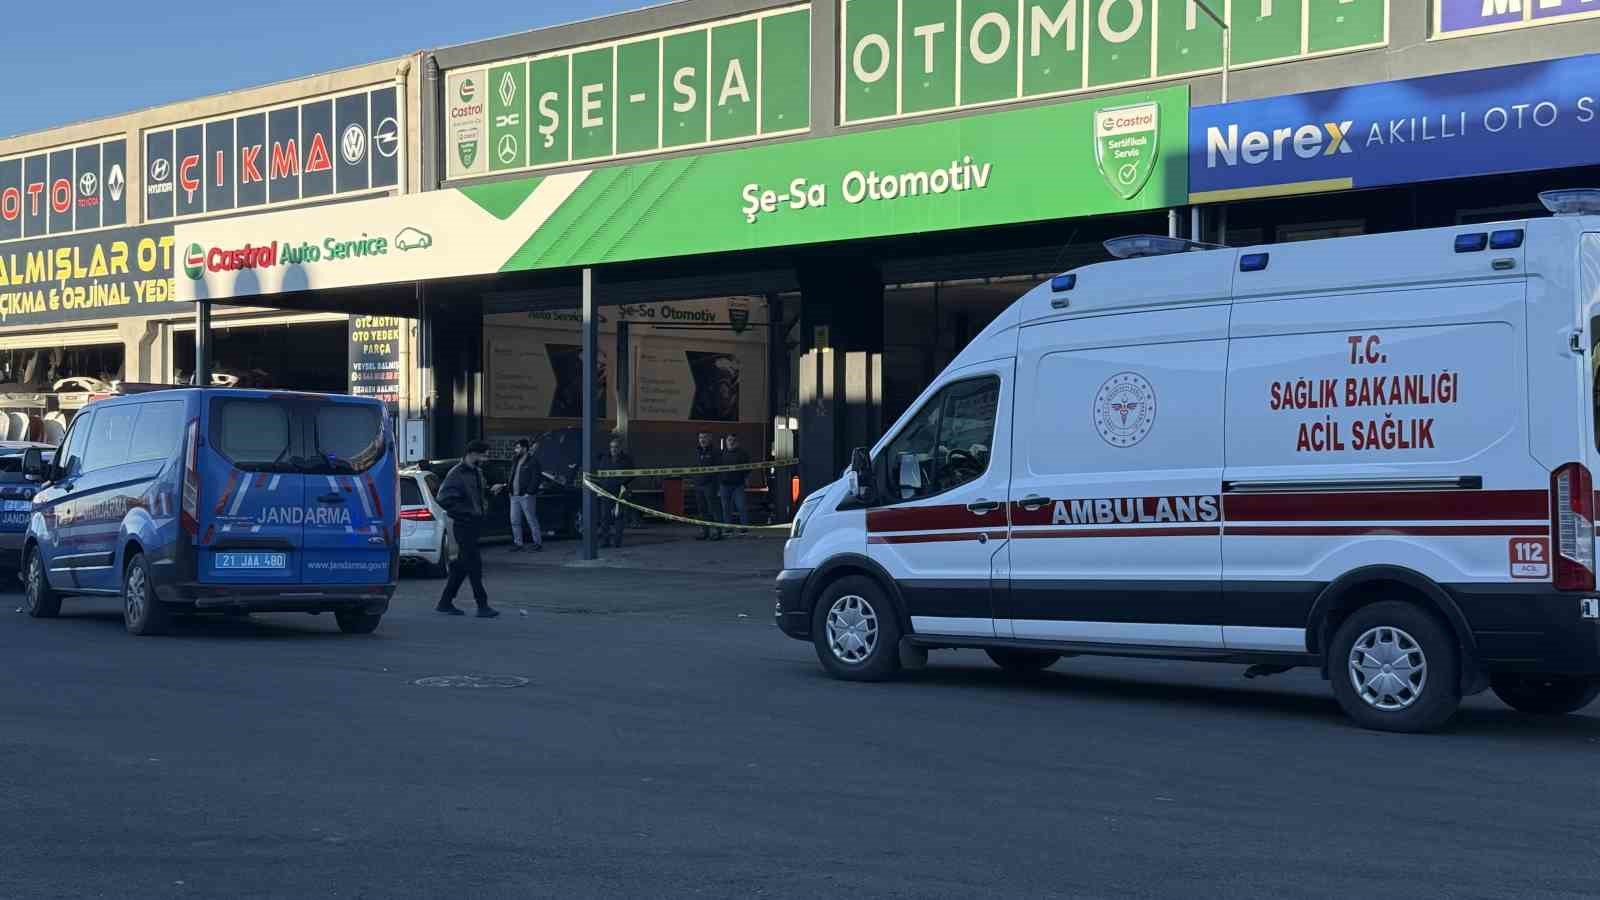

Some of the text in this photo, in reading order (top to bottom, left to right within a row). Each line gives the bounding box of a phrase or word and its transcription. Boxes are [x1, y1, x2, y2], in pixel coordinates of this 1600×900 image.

[853, 0, 1351, 83] OTOMO
[451, 104, 483, 118] Castrol
[538, 58, 750, 148] ŞE-SA
[1115, 113, 1153, 128] Castrol
[1206, 120, 1353, 168] Nerex
[1366, 112, 1464, 147] AKILLI
[1483, 101, 1558, 133] OTO
[180, 132, 333, 204] ÇIKMA
[1114, 148, 1140, 159] Servis
[1, 178, 72, 221] OTO
[742, 155, 992, 224] Şe-Sa Otomotiv
[207, 233, 388, 273] Castrol Auto Service
[0, 290, 46, 321] ÇIKMA
[50, 289, 60, 310] &
[618, 302, 655, 319] Şe-Sa
[661, 304, 717, 322] Otomotiv
[352, 329, 399, 342] OTO YEDEK
[363, 343, 391, 356] PARÇA
[1347, 336, 1387, 364] T.C.
[1270, 369, 1458, 411] SAĞLIK BAKANLIĞI
[1296, 411, 1435, 452] ACİL SAĞLIK
[257, 506, 352, 525] JANDARMA
[1052, 496, 1219, 525] AMBULANS
[223, 555, 283, 568] 21 JAA 480
[1515, 542, 1544, 562] 112
